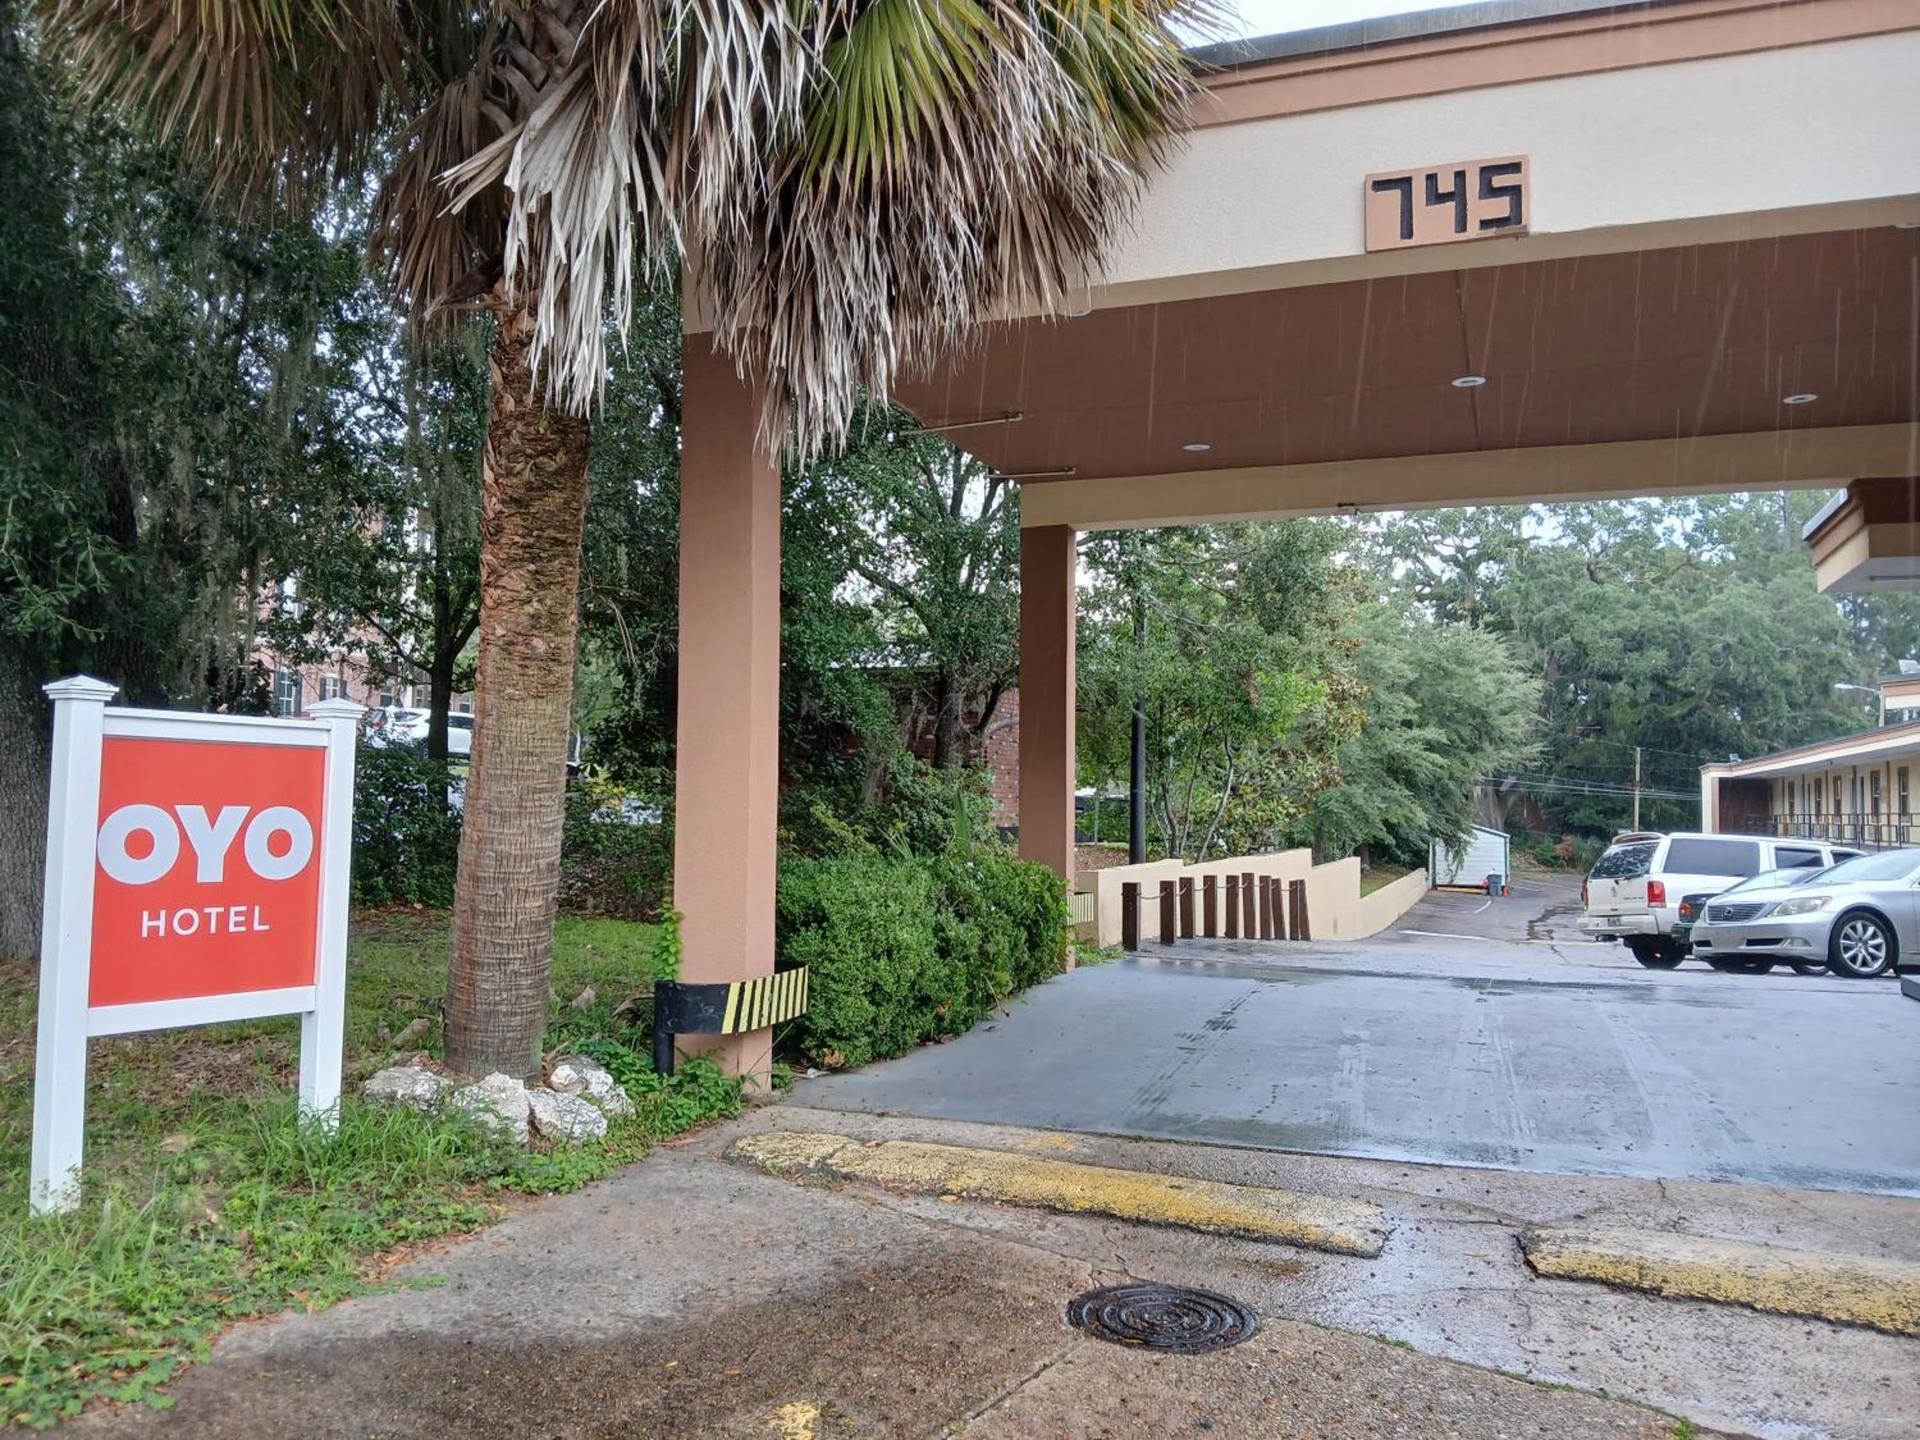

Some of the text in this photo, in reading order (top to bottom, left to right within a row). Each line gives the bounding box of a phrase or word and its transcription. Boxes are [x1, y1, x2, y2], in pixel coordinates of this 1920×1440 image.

[1372, 161, 1522, 239] 745
[97, 804, 313, 885] OYO
[141, 905, 270, 938] HOTEL
